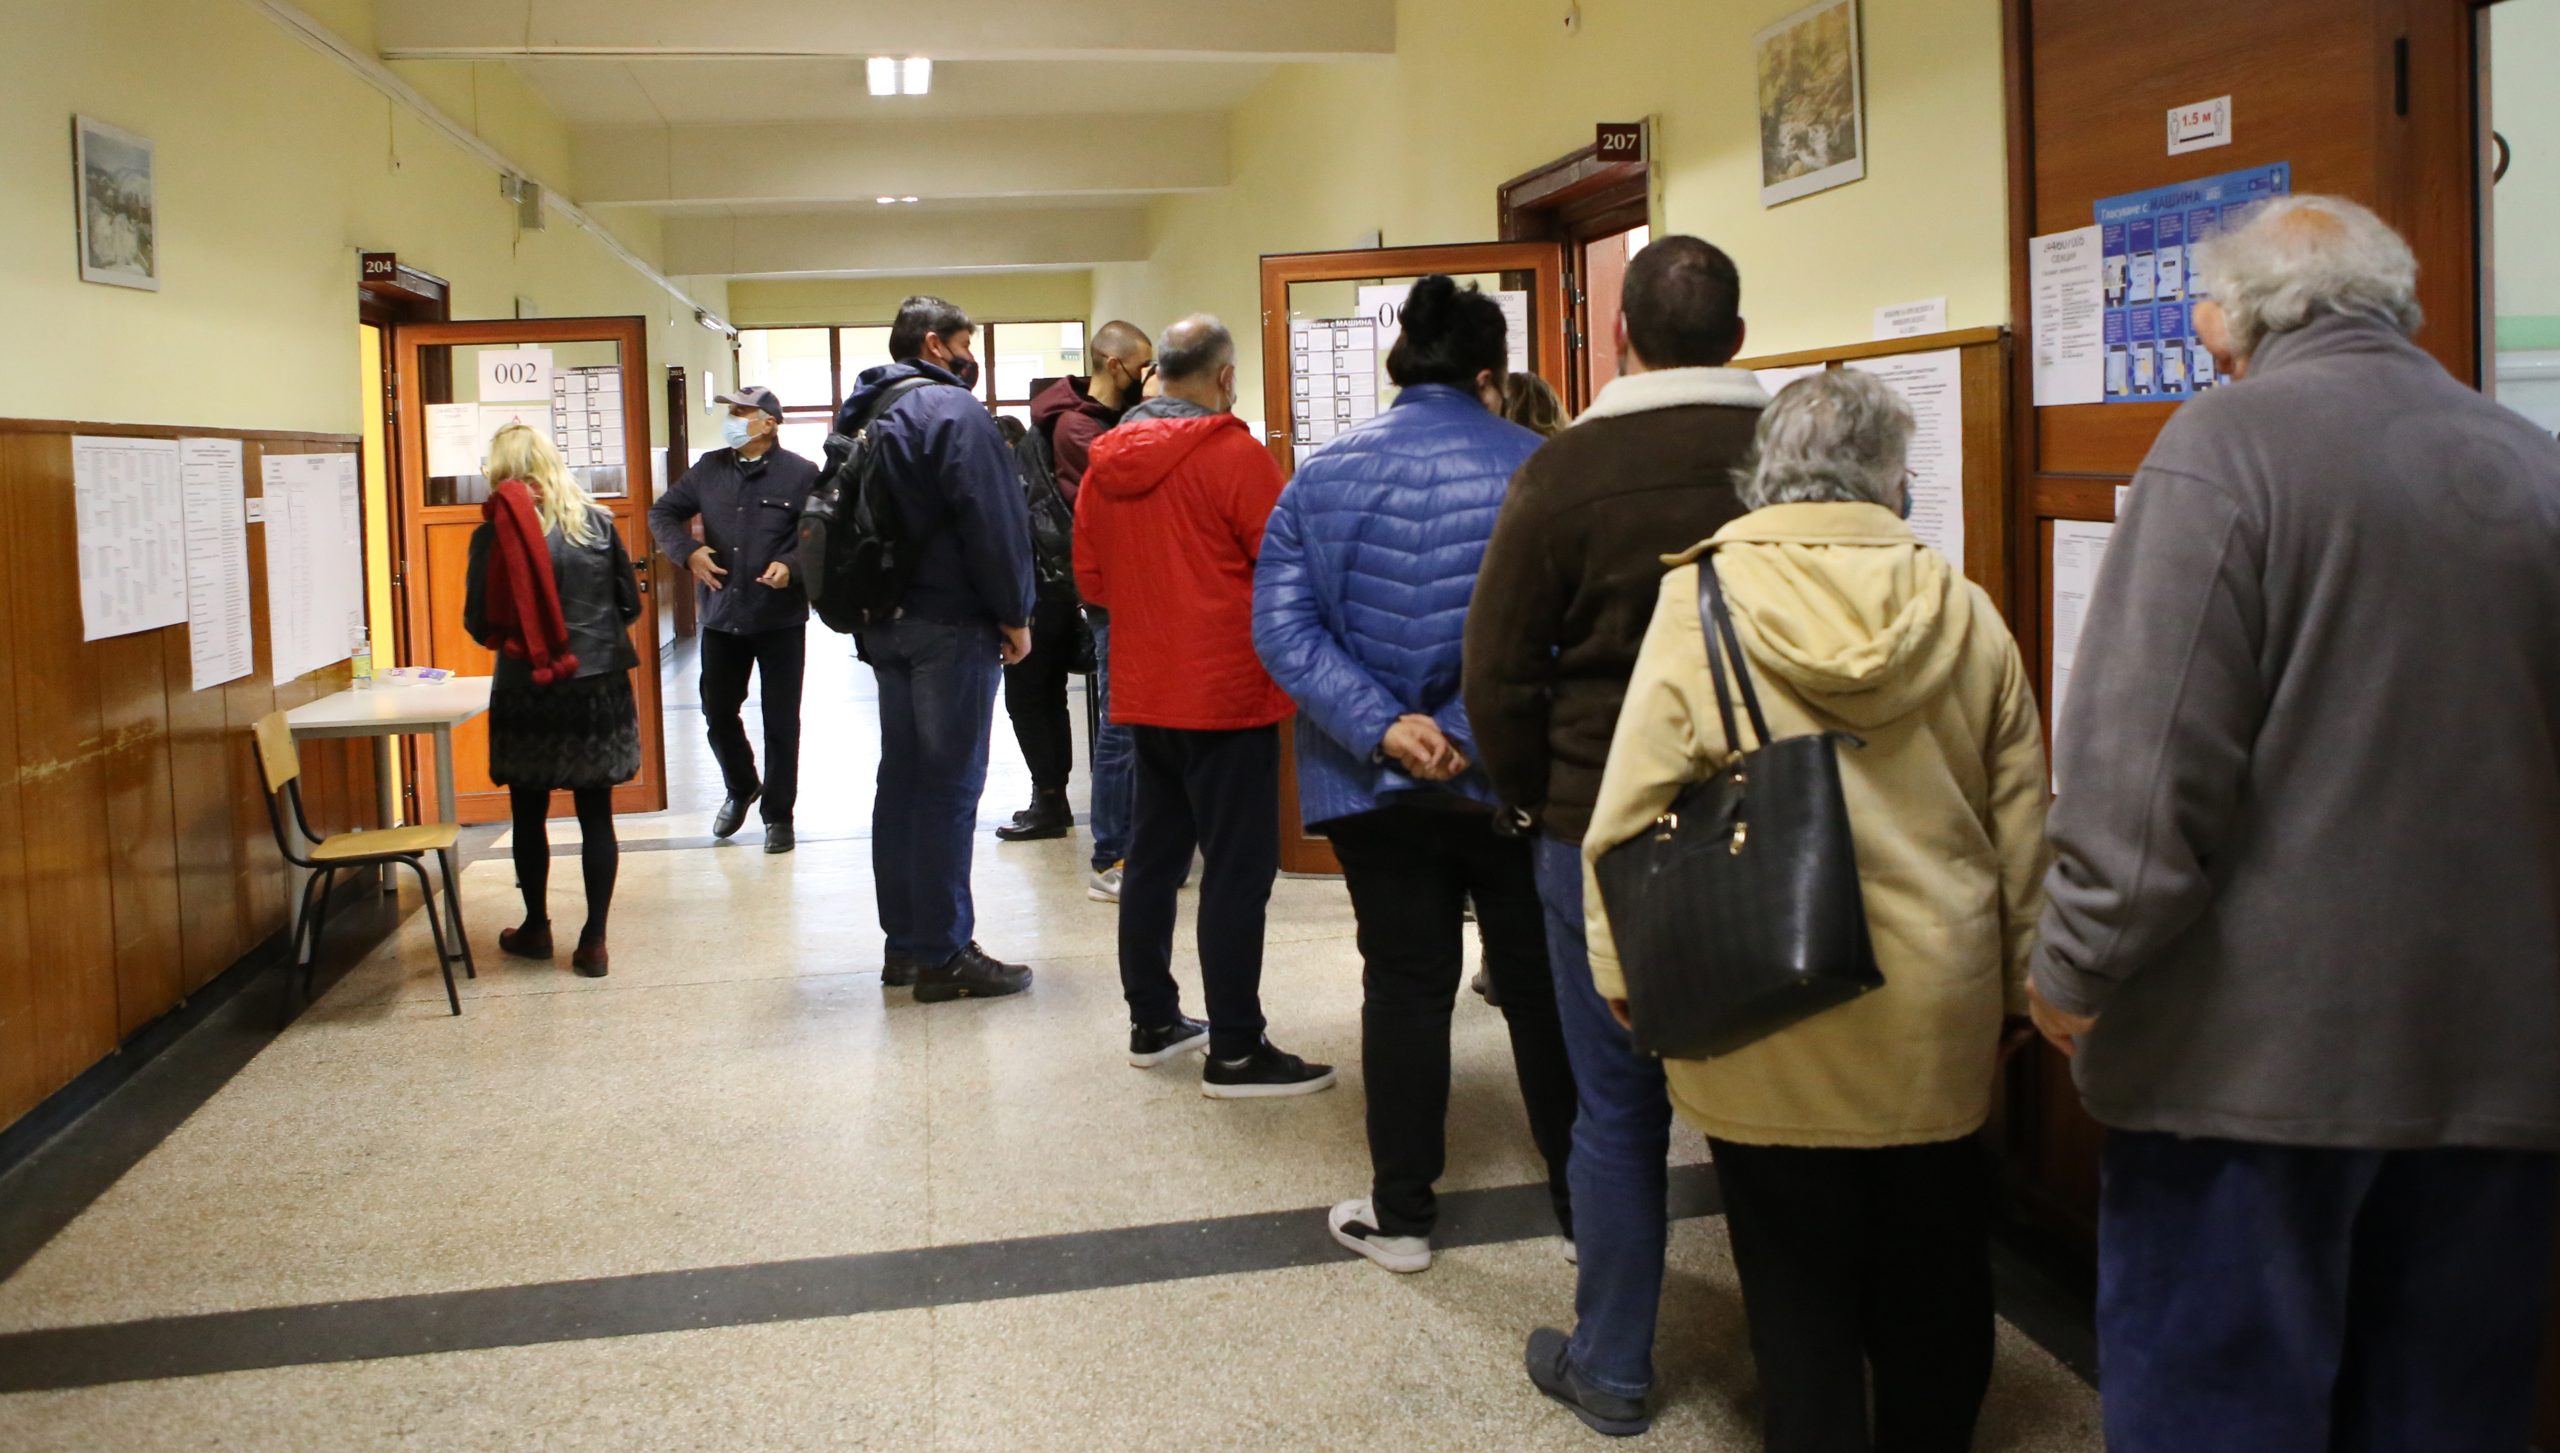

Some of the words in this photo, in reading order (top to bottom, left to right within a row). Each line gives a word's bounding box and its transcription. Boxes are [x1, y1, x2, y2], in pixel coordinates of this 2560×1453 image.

[2182, 112, 2199, 127] 1.5
[1603, 133, 1637, 150] 207
[2149, 190, 2200, 212] МАШИНА
[366, 260, 392, 273] 204
[1336, 318, 1373, 327] МАШИНА
[495, 362, 537, 384] 002
